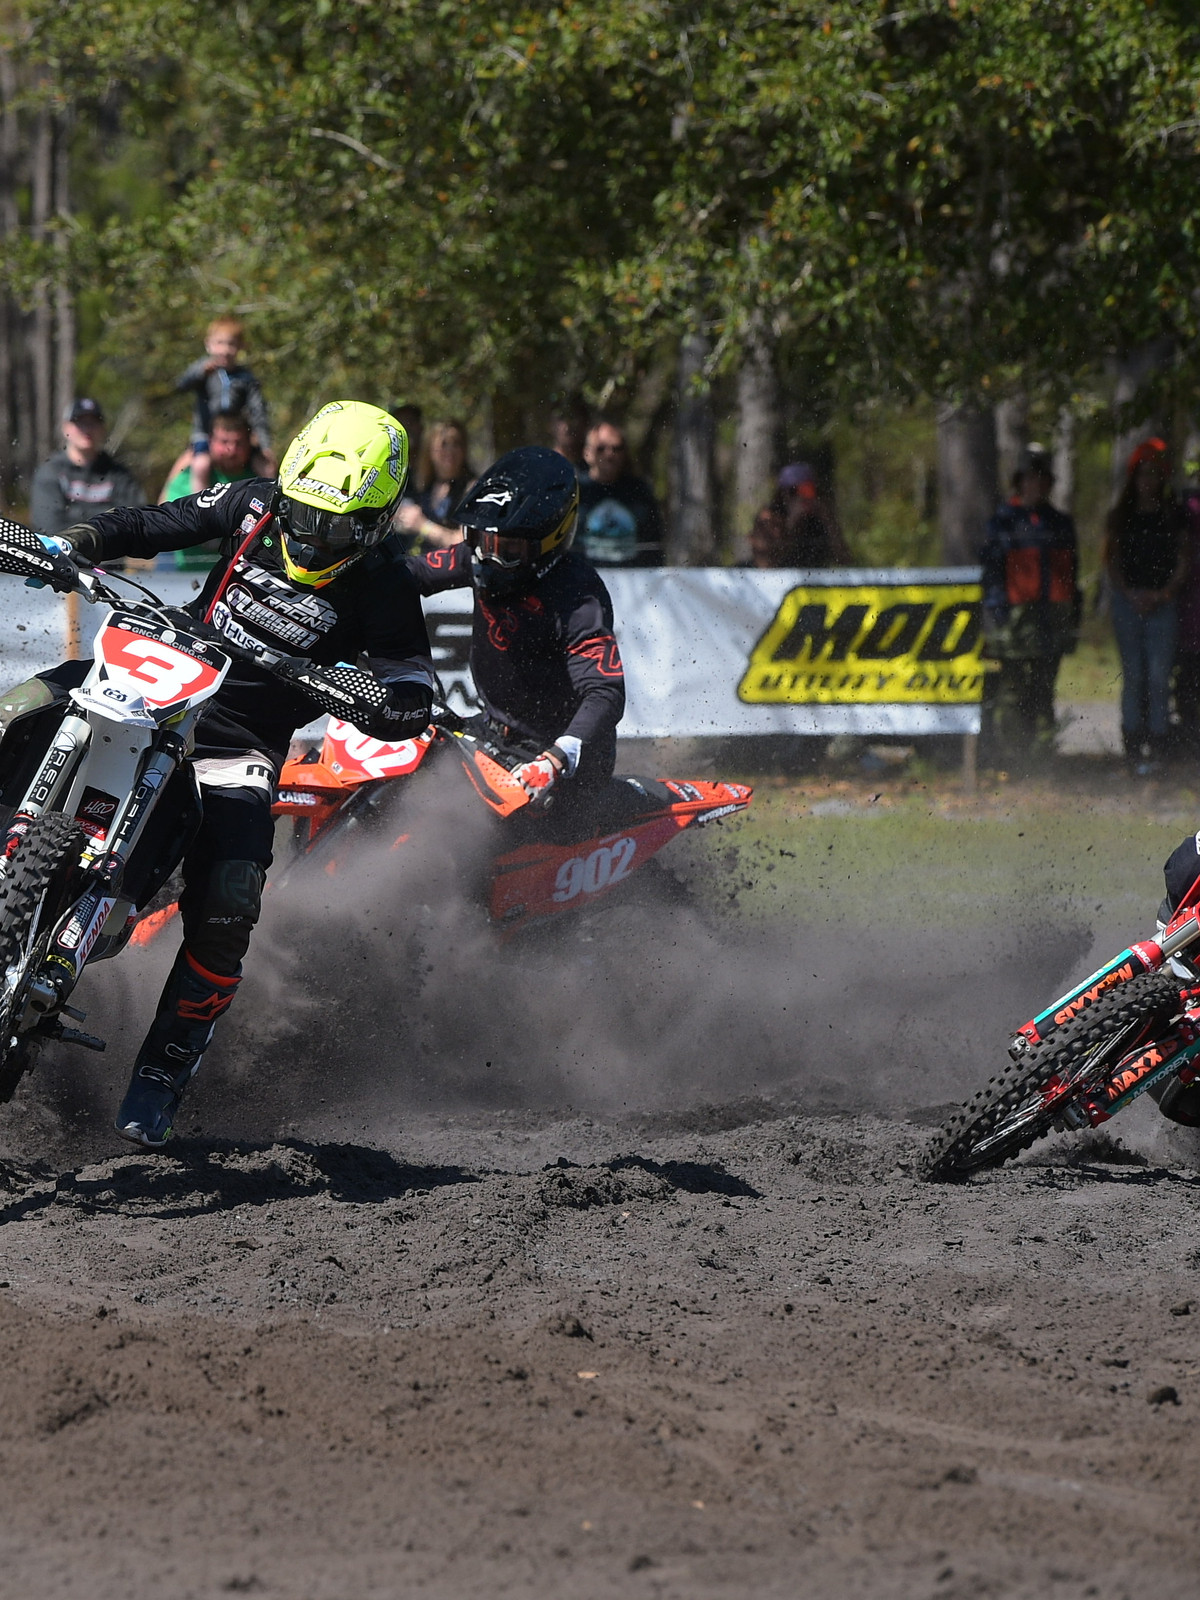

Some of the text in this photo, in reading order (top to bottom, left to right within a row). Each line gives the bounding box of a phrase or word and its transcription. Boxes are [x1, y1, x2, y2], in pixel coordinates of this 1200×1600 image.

[262, 595, 334, 634] RACING
[120, 638, 204, 702] 3
[298, 675, 355, 705] ACERBIS
[552, 836, 637, 903] 902
[79, 900, 111, 963] KENDA
[1054, 963, 1134, 1026] MXXIS
[1132, 1053, 1189, 1099] MOTOREX
